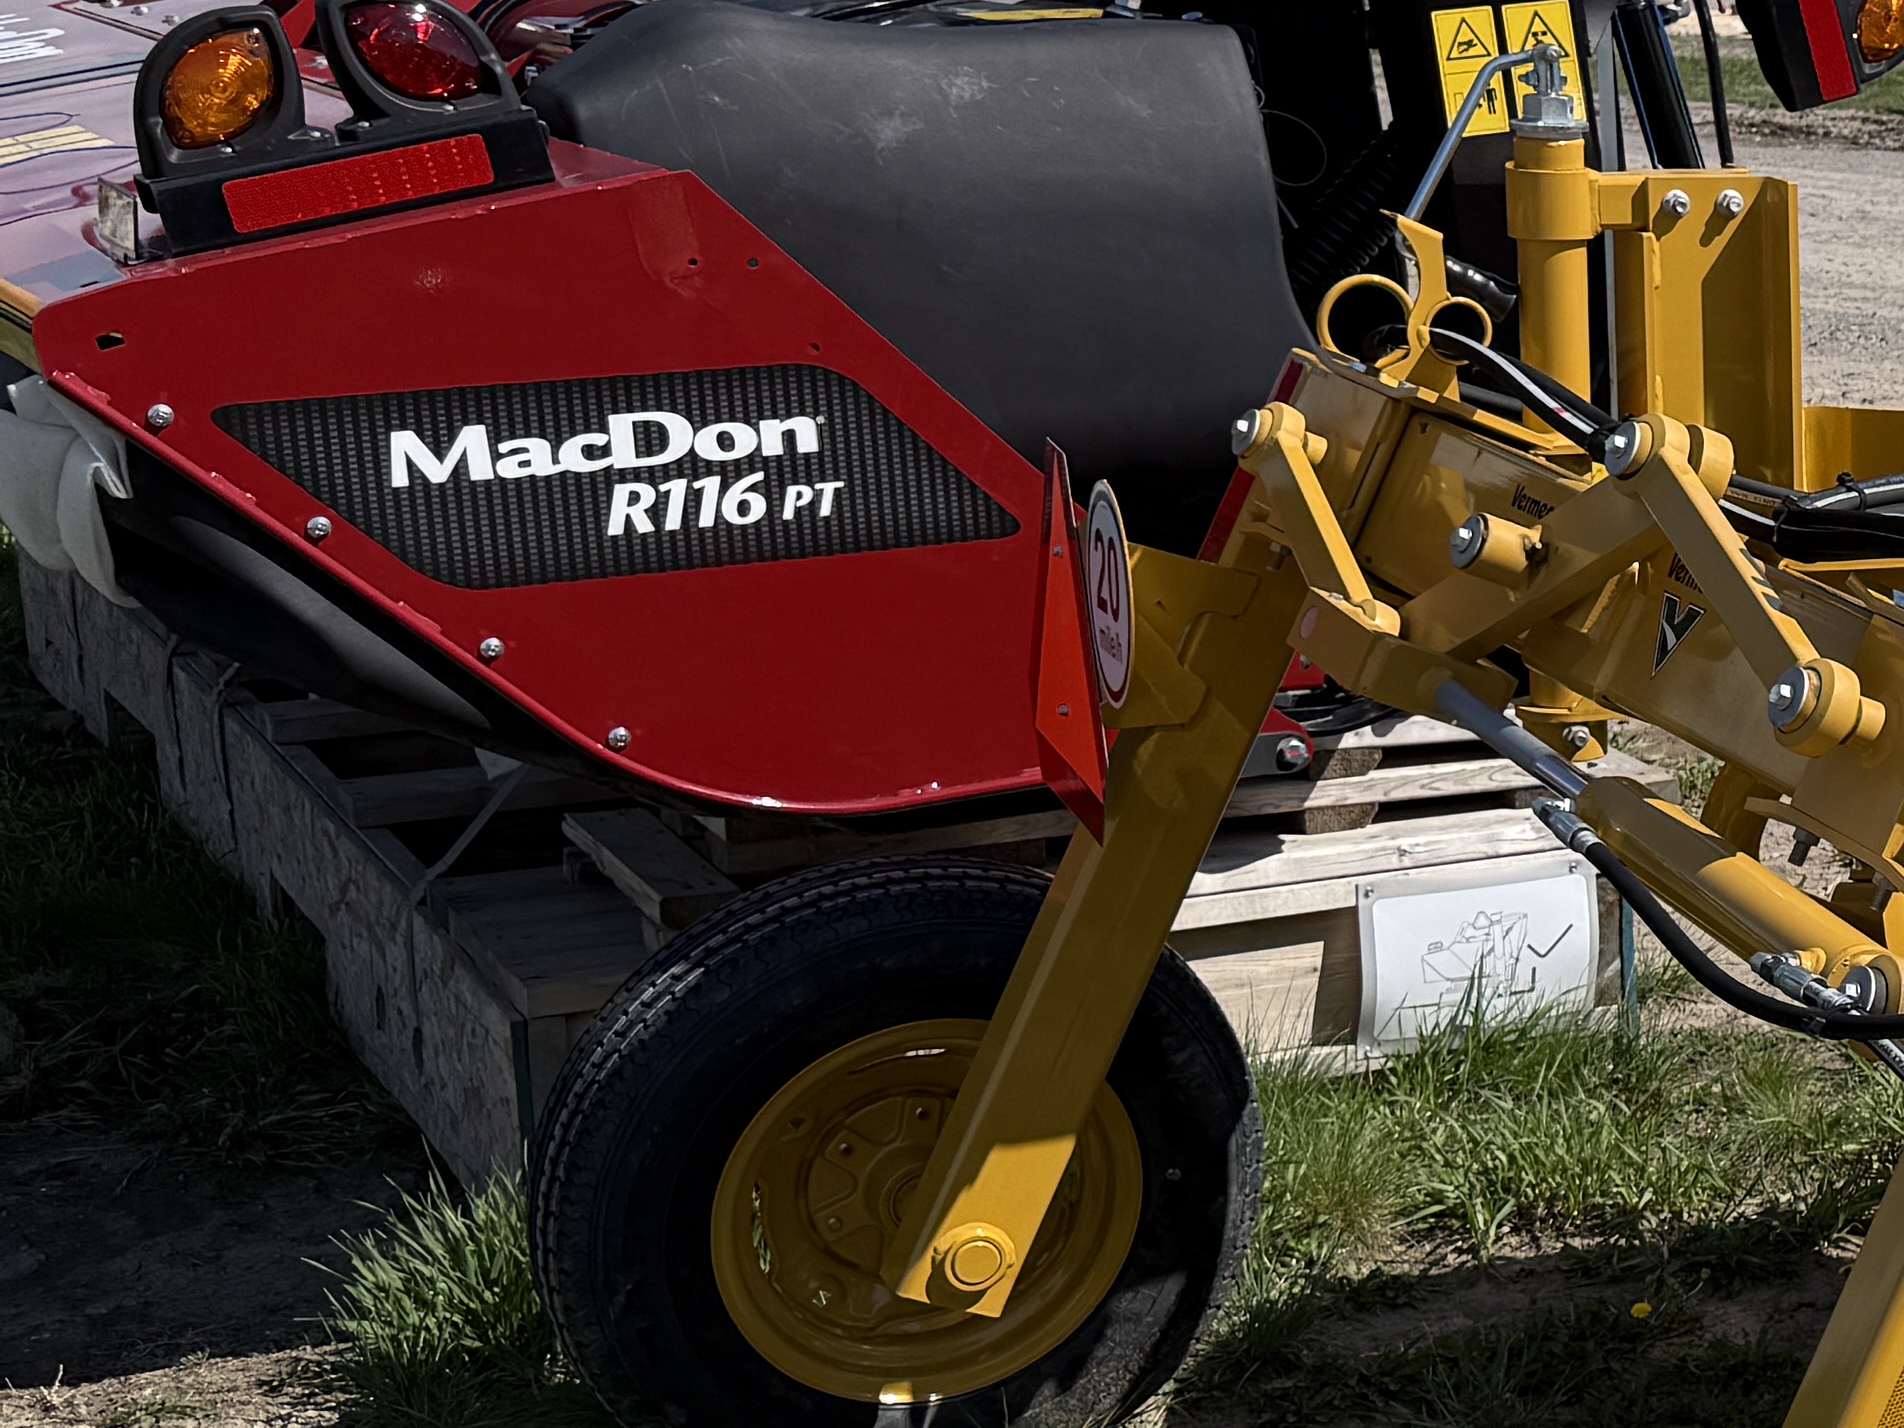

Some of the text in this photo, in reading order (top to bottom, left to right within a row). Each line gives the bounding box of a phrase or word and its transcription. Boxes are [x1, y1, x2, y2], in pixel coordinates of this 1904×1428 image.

[391, 411, 819, 488] MacDon
[607, 472, 844, 537] R116 PT
[1095, 528, 1120, 623] 20
